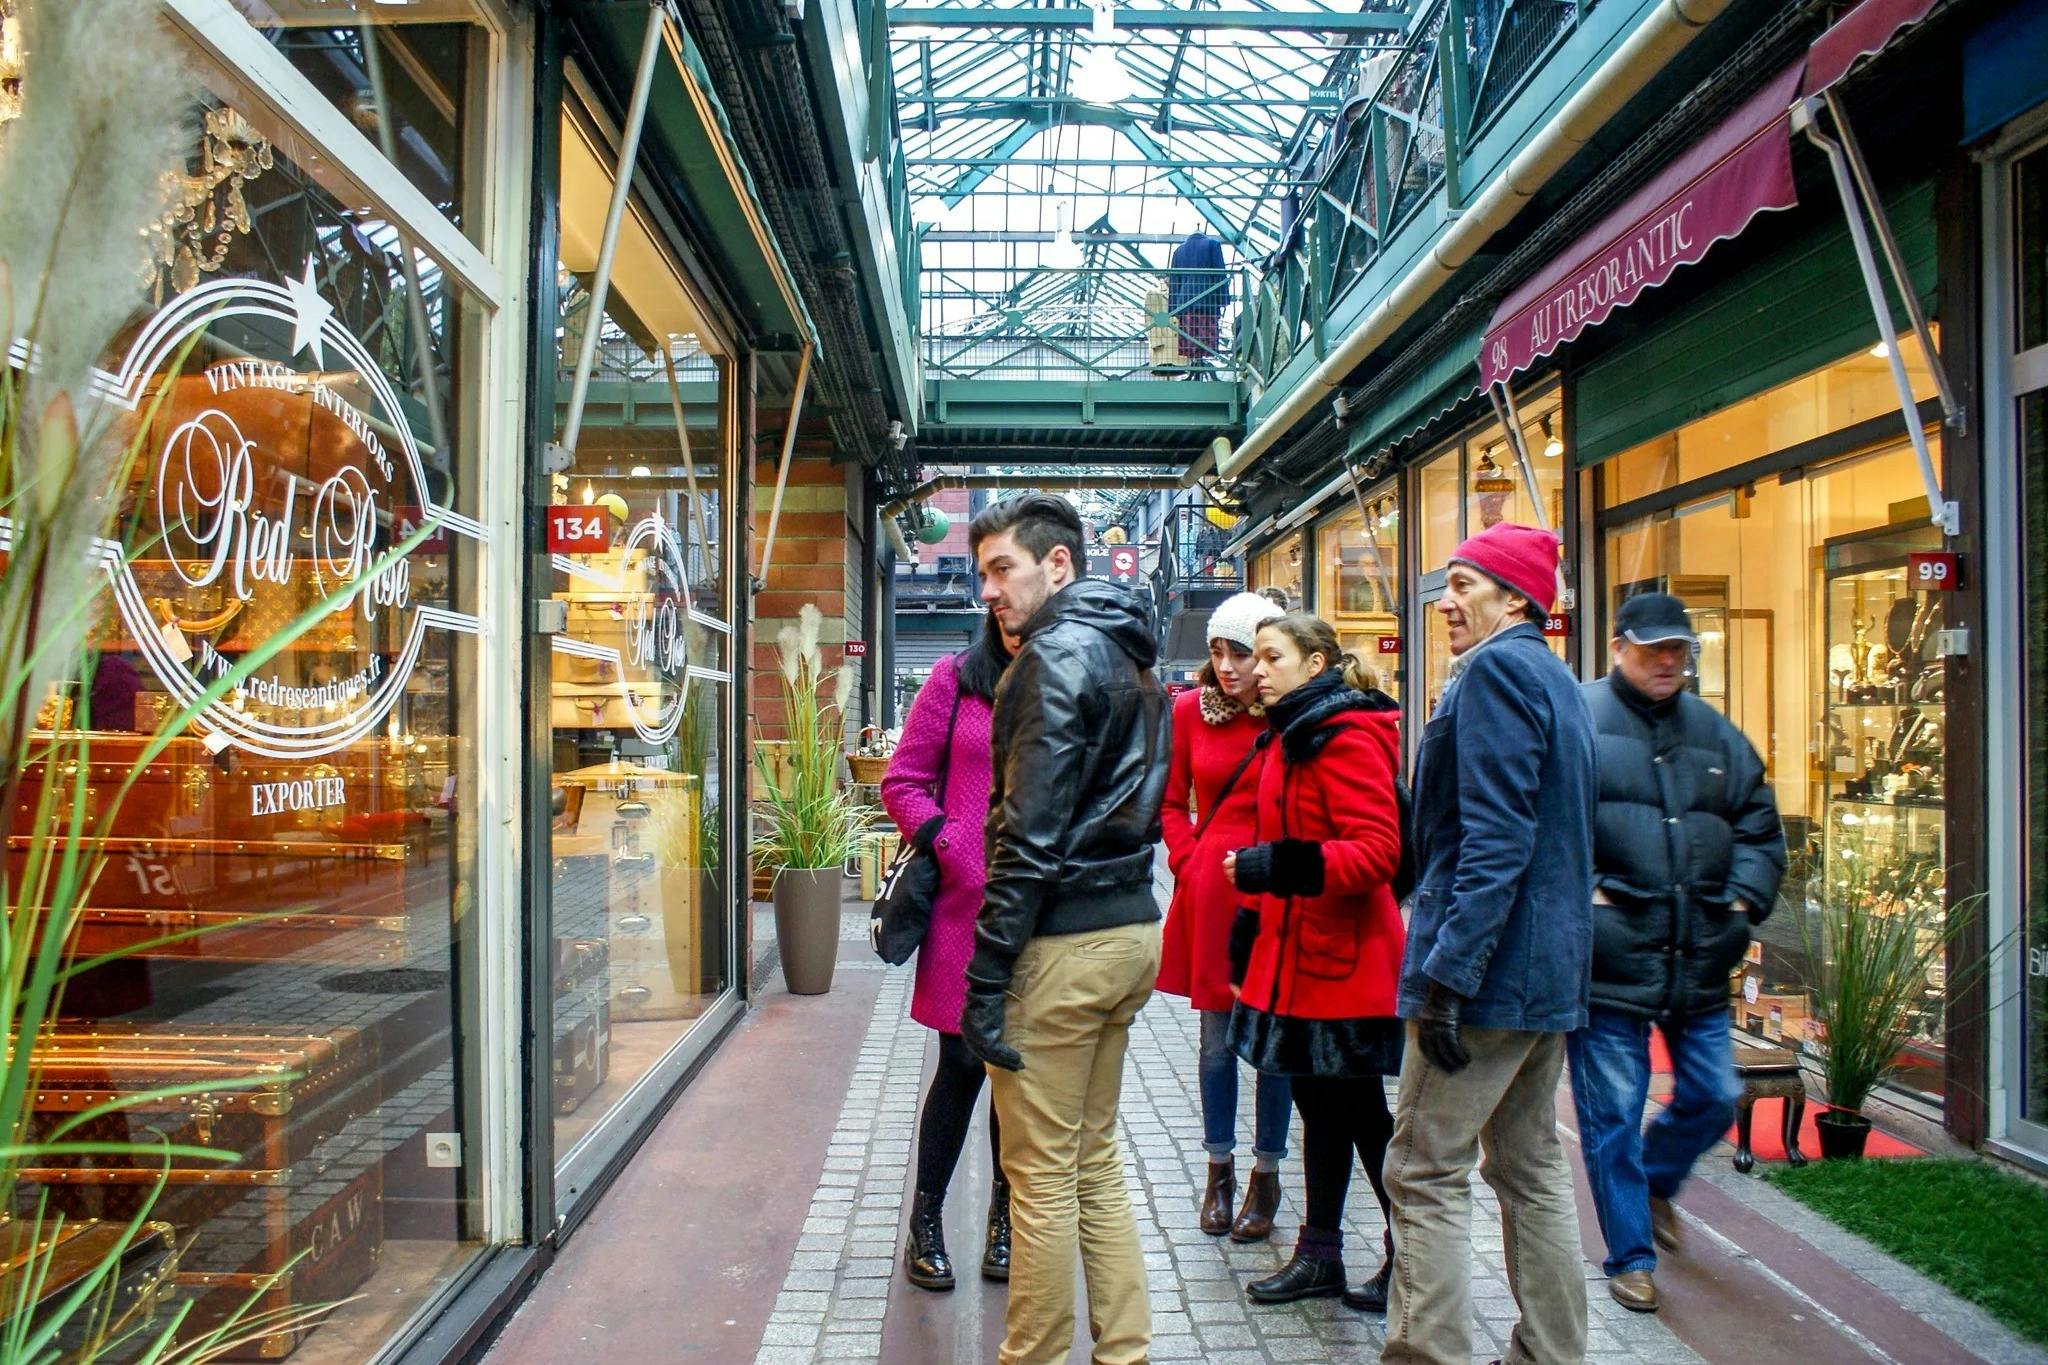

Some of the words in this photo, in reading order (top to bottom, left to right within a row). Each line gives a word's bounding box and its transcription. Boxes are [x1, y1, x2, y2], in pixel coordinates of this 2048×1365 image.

[1492, 336, 1508, 376] 98
[1530, 303, 1551, 352] AU
[1554, 201, 1693, 335] TRESORANTIC
[204, 361, 298, 396] VINTAGE
[313, 379, 394, 483] INTERIORS
[158, 409, 296, 600] Red
[313, 465, 411, 622] Rose
[554, 517, 603, 540] 134
[1084, 548, 1110, 557] IQUE
[1918, 562, 1947, 580] 99
[1545, 618, 1563, 630] 98
[849, 644, 865, 653] 130
[1382, 640, 1396, 650] 97
[202, 639, 382, 709] www.redroseantiques.fr
[251, 776, 346, 816] EXPORTER
